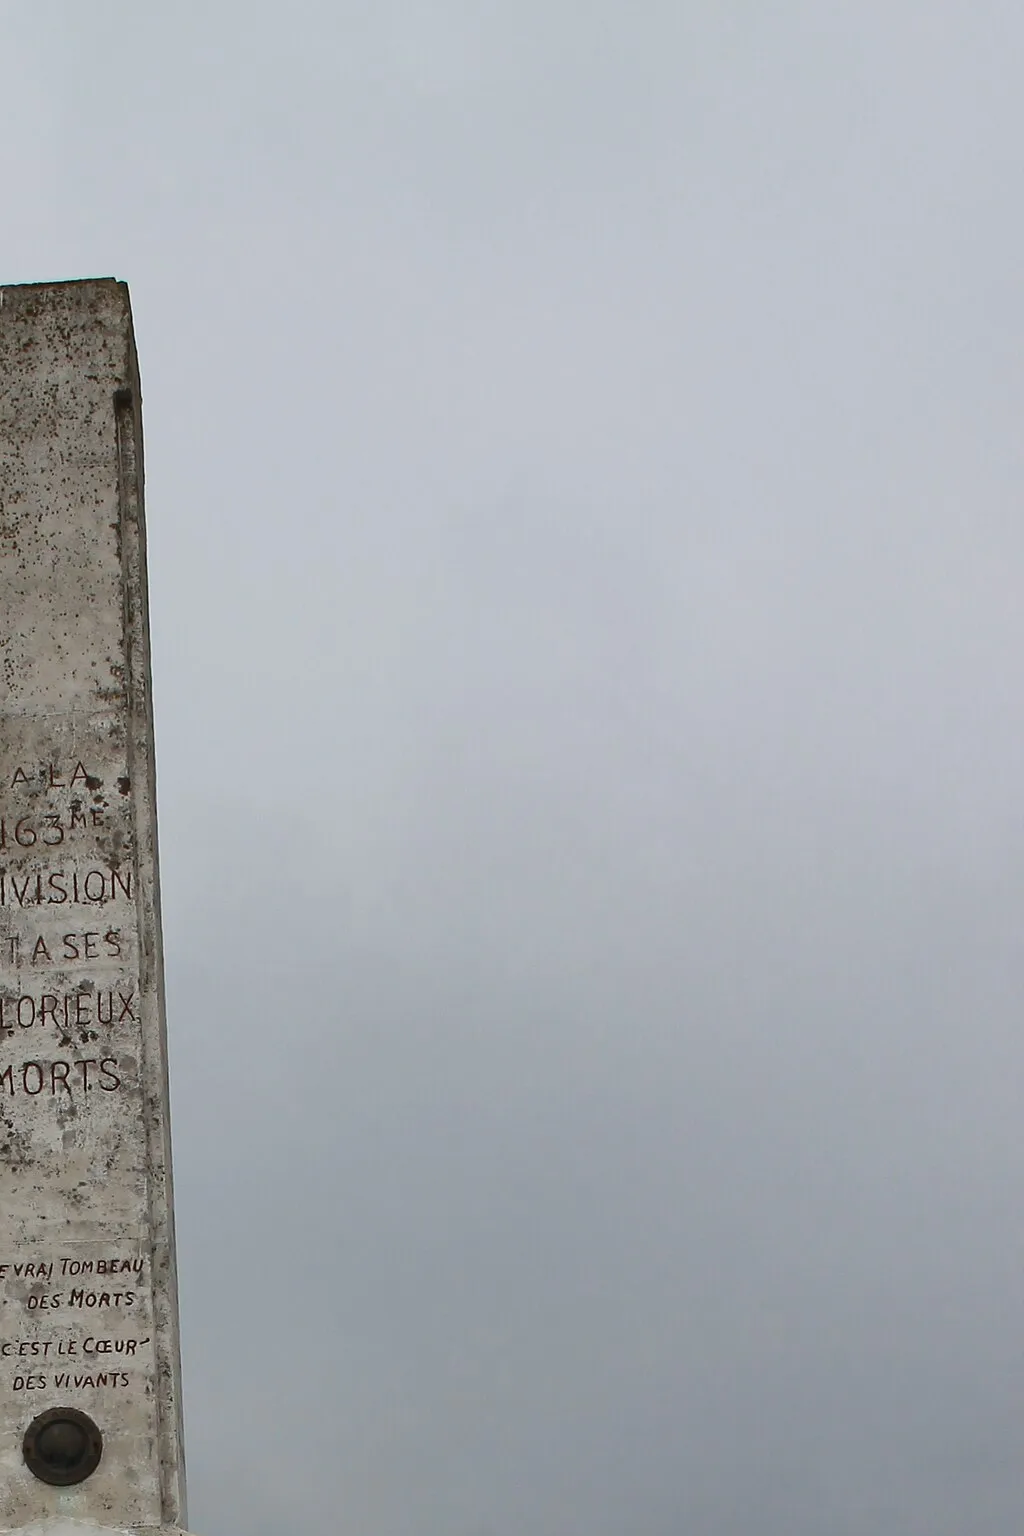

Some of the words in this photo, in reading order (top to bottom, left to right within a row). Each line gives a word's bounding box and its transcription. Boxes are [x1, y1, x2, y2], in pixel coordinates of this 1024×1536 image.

[10, 766, 29, 789] A
[49, 760, 89, 788] LA
[32, 935, 52, 962] A
[62, 931, 123, 961] SES
[14, 1262, 54, 1280] VRAI
[59, 1258, 145, 1276] TOMBEAU
[27, 1294, 61, 1310] DES
[69, 1288, 136, 1309] MORTS
[57, 1338, 78, 1355] LE
[12, 1375, 47, 1391] DES
[54, 1372, 130, 1389] VIVANTS
